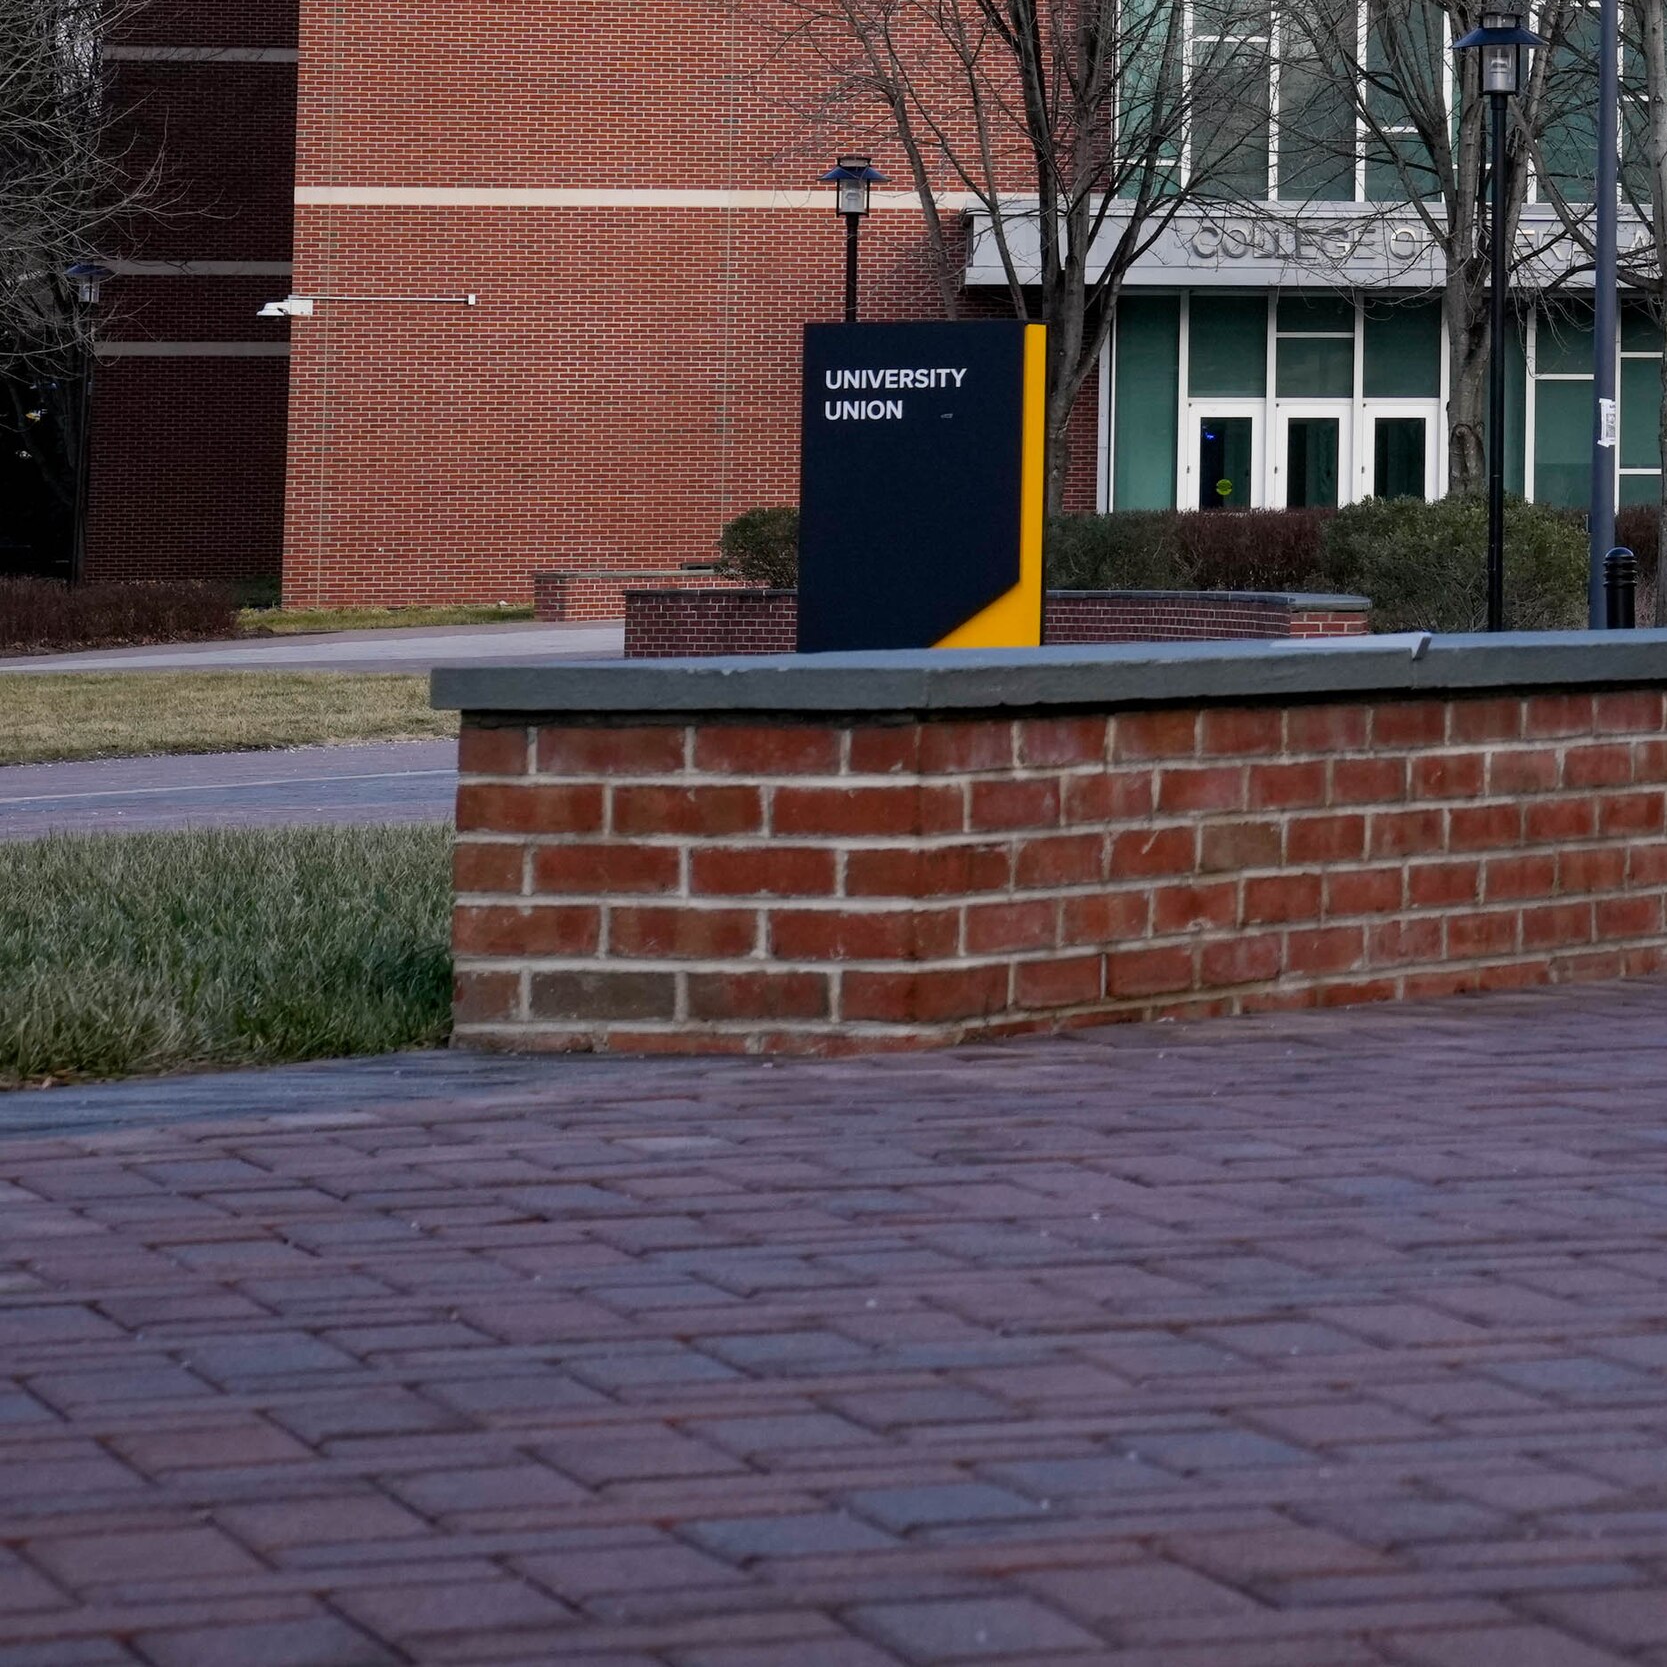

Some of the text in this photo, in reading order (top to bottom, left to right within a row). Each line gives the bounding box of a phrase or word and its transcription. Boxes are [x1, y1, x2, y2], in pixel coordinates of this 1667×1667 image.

[1190, 226, 1377, 260] COLLEGE
[1389, 227, 1441, 261] OF
[825, 368, 967, 390] UNIVERSITY
[824, 400, 903, 421] UNION
